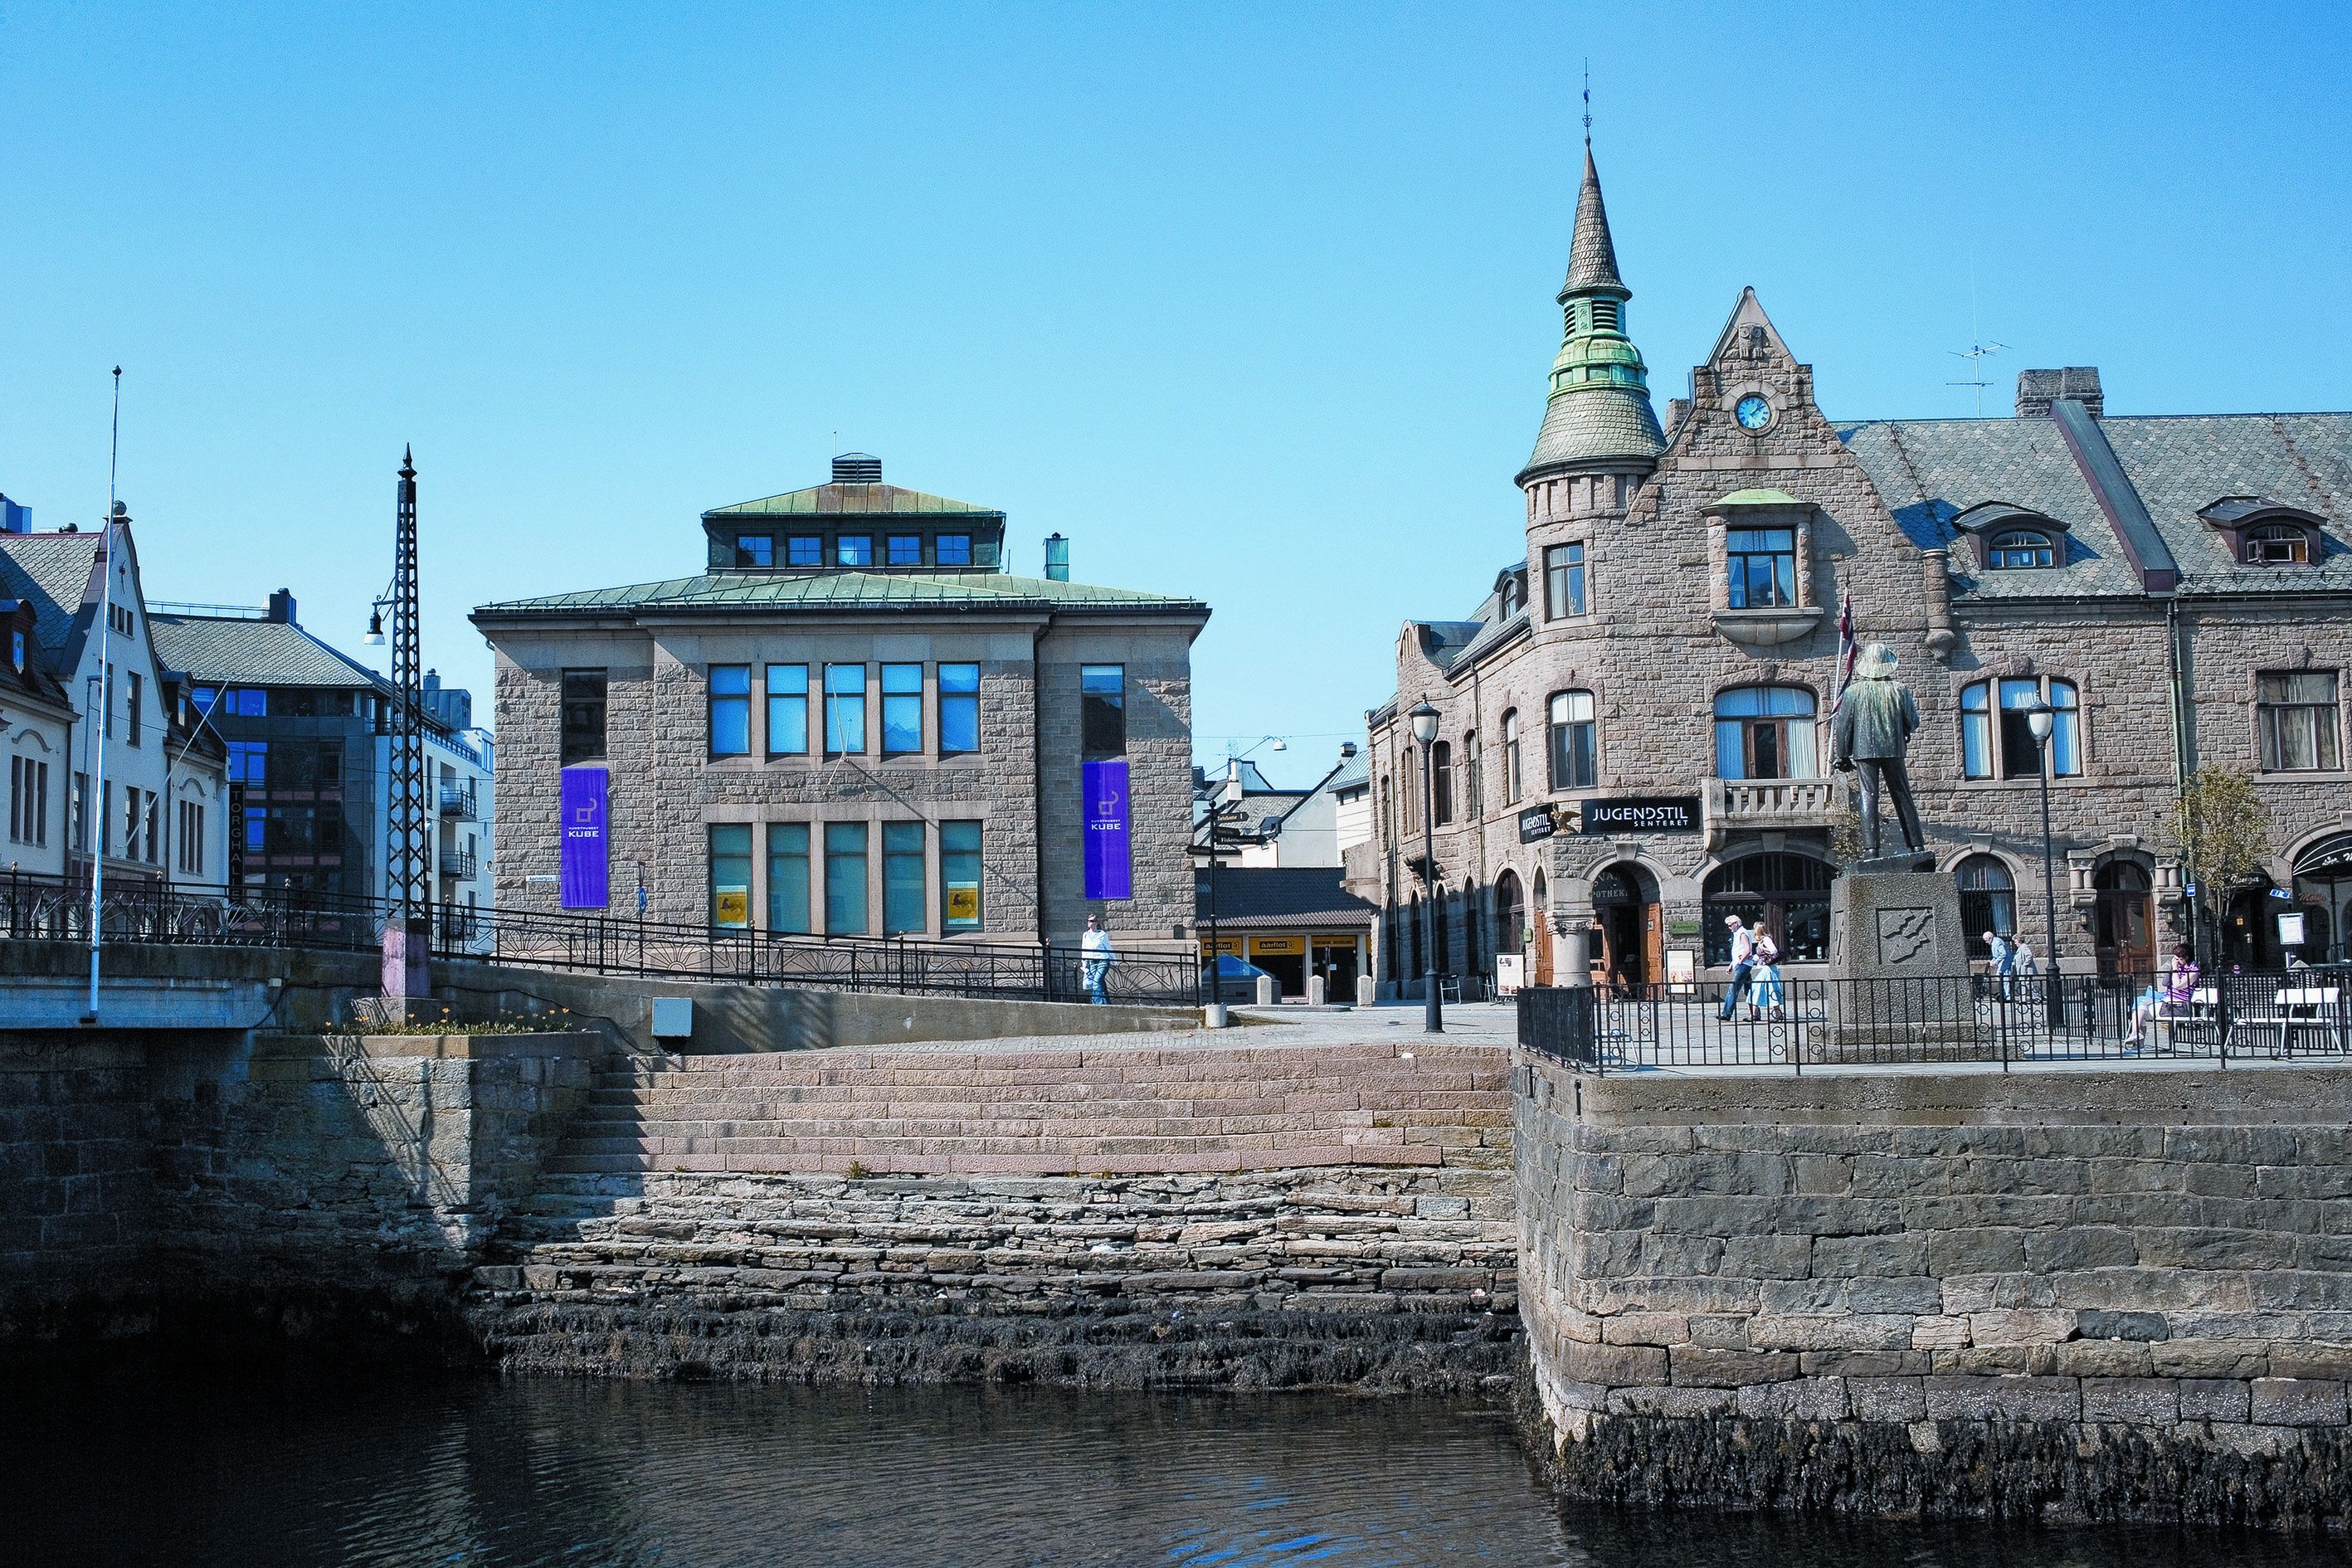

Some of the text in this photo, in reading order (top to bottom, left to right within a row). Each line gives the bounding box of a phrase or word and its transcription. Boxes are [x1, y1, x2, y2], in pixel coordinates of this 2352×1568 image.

[1593, 806, 1688, 821] JUGENDSTIL
[1522, 813, 1551, 831] JUGENDSTIL
[1531, 825, 1551, 835] SENTERET
